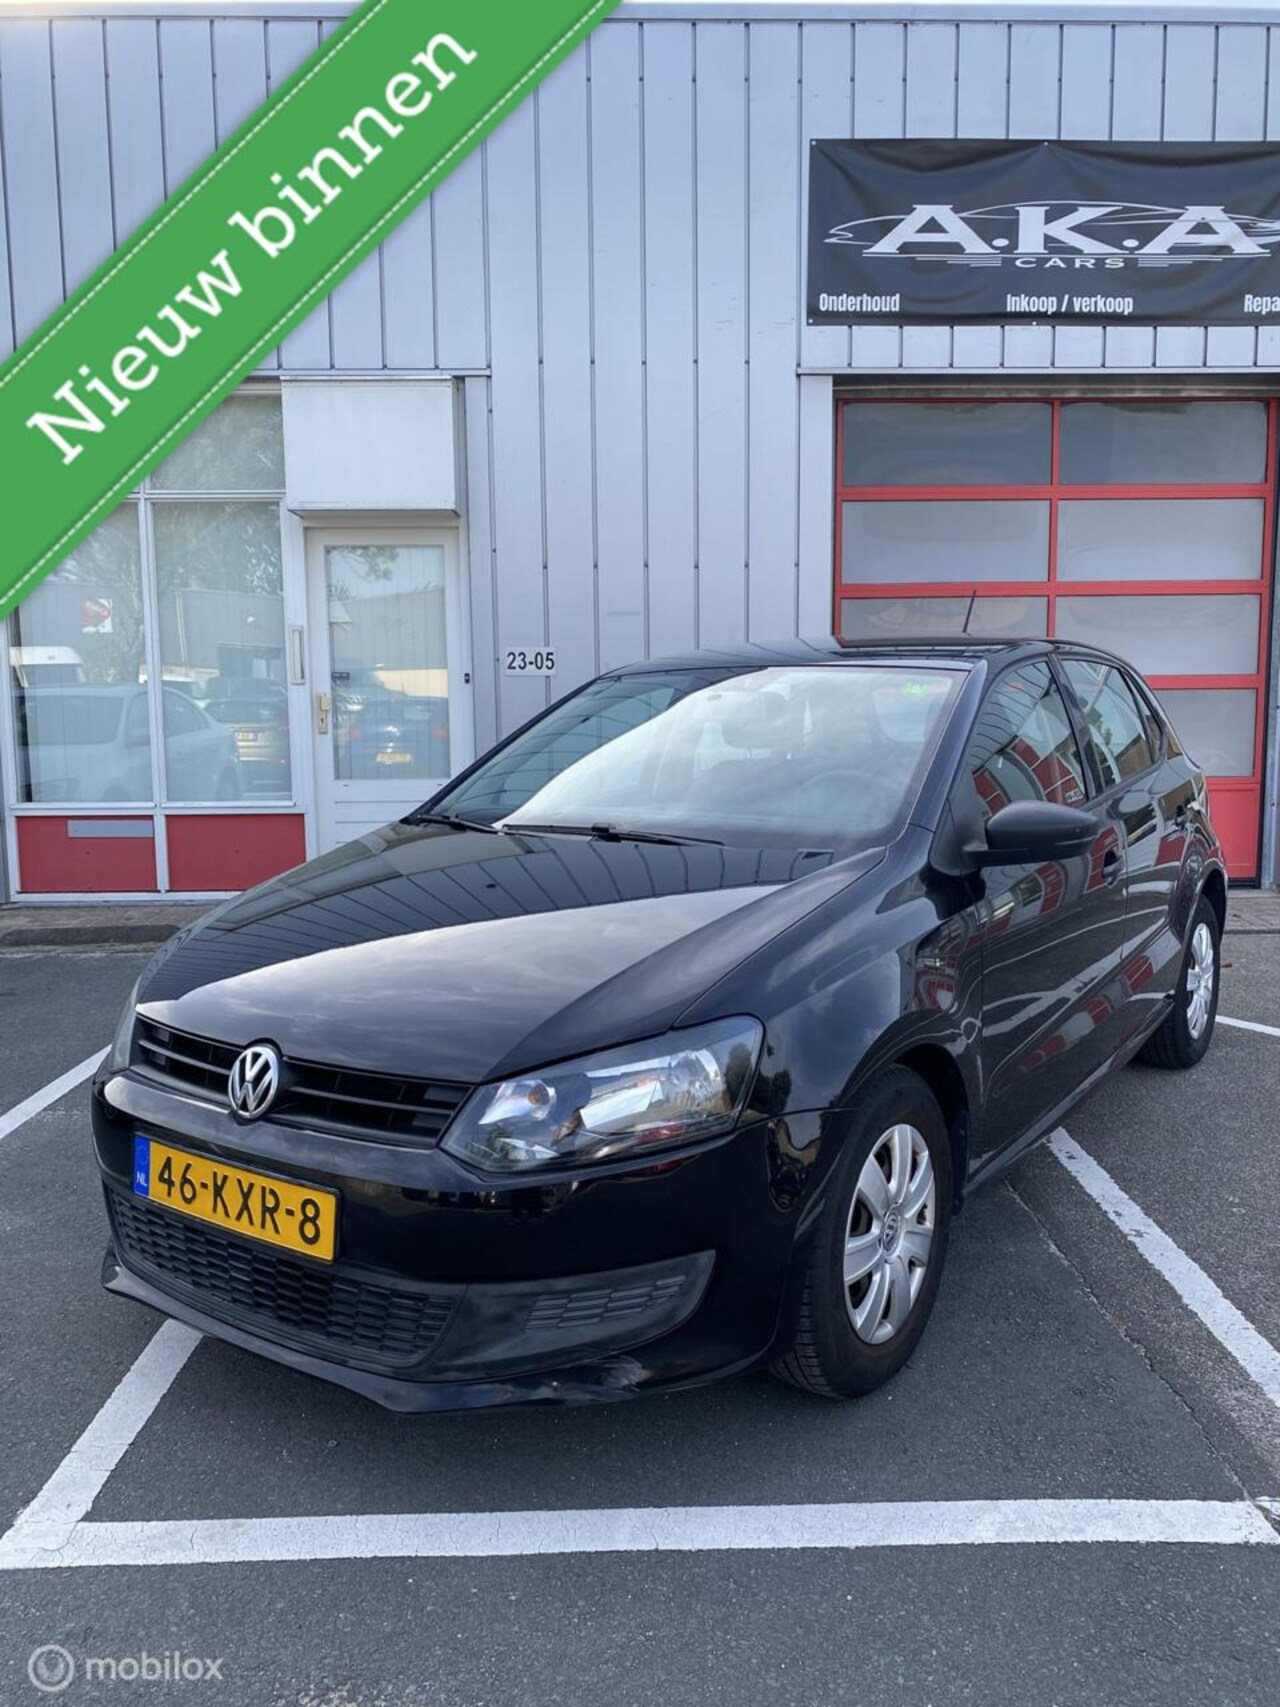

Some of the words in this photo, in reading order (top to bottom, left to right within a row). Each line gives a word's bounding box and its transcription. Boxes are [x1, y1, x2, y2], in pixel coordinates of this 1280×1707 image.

[1015, 257, 1125, 269] CARS
[819, 293, 900, 312] Onderhoud
[1006, 293, 1057, 315] Inkoop
[1073, 294, 1134, 315] verkoop
[507, 651, 555, 670] 23-05
[136, 1170, 148, 1187] NL
[158, 1156, 321, 1245] 46-KXR-8
